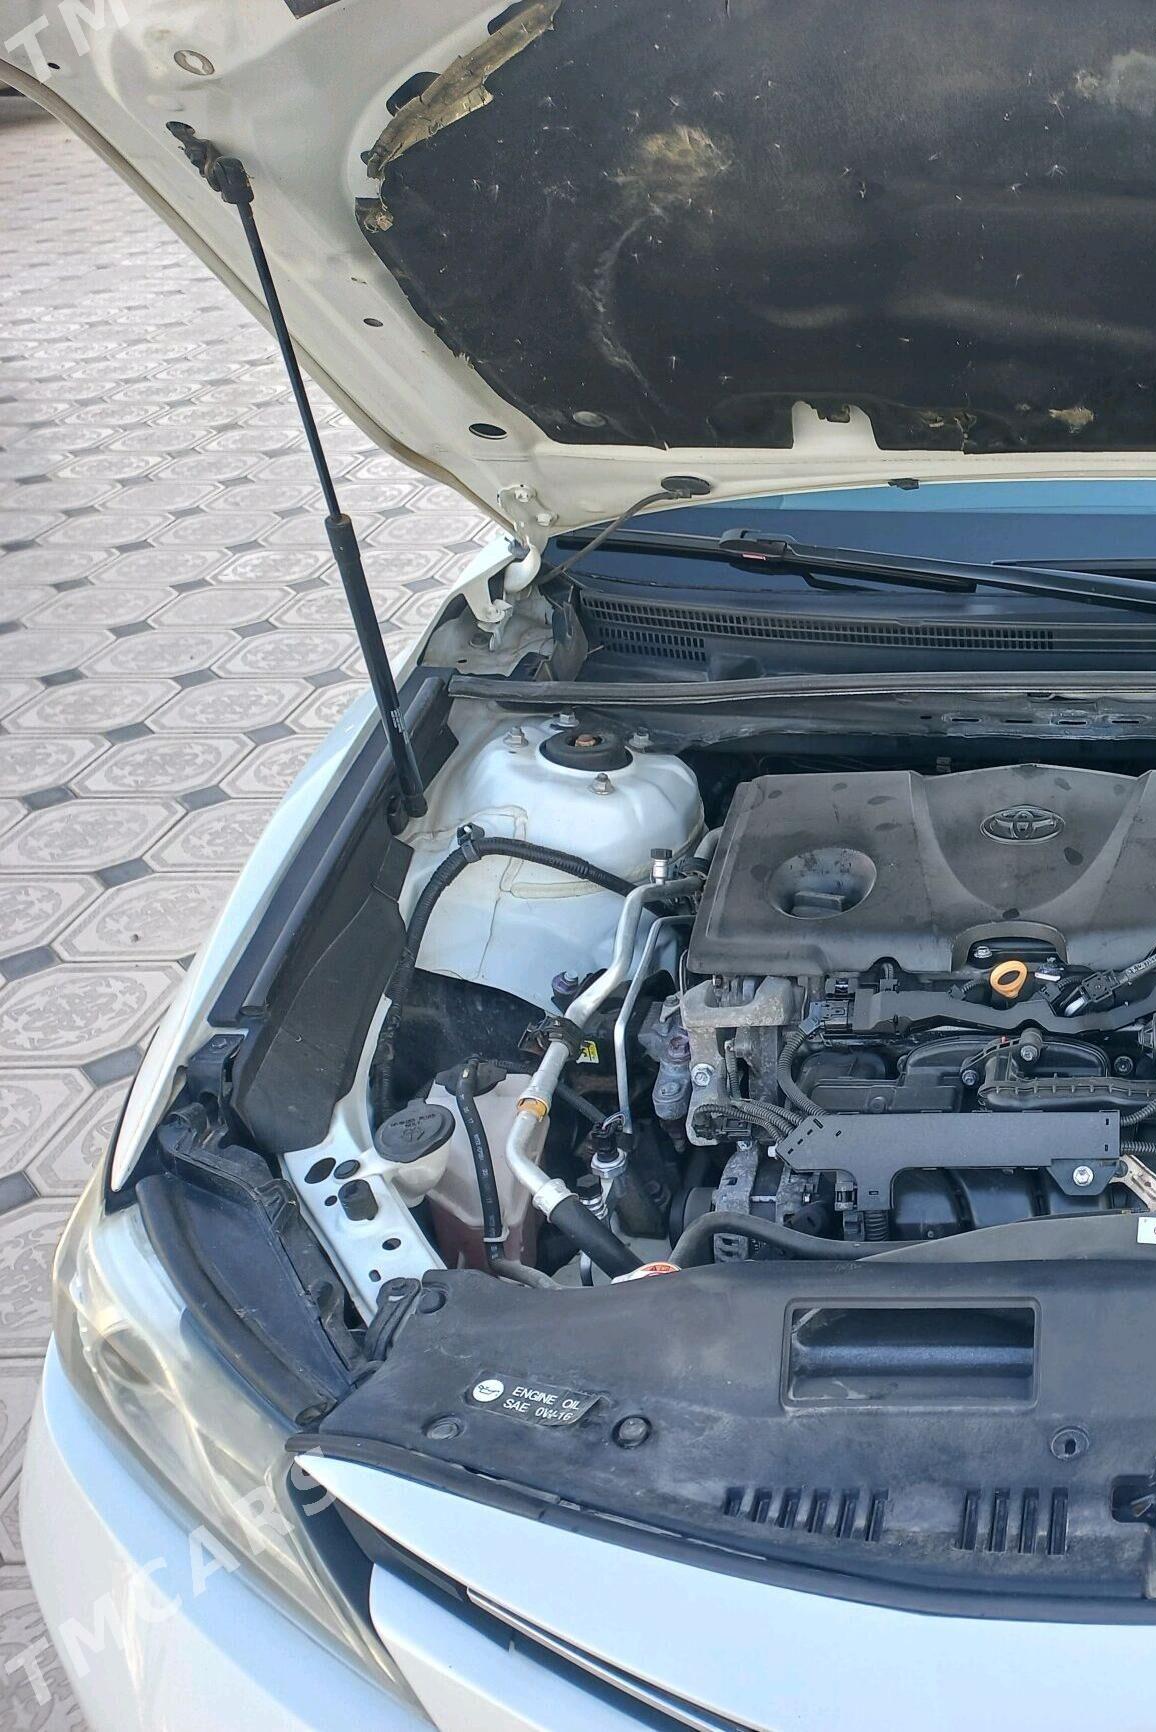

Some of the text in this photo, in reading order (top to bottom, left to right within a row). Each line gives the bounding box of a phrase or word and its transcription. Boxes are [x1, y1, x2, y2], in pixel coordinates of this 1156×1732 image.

[503, 1398, 574, 1421] SAE 0W-16
[512, 1386, 582, 1411] ENGINE OIL
